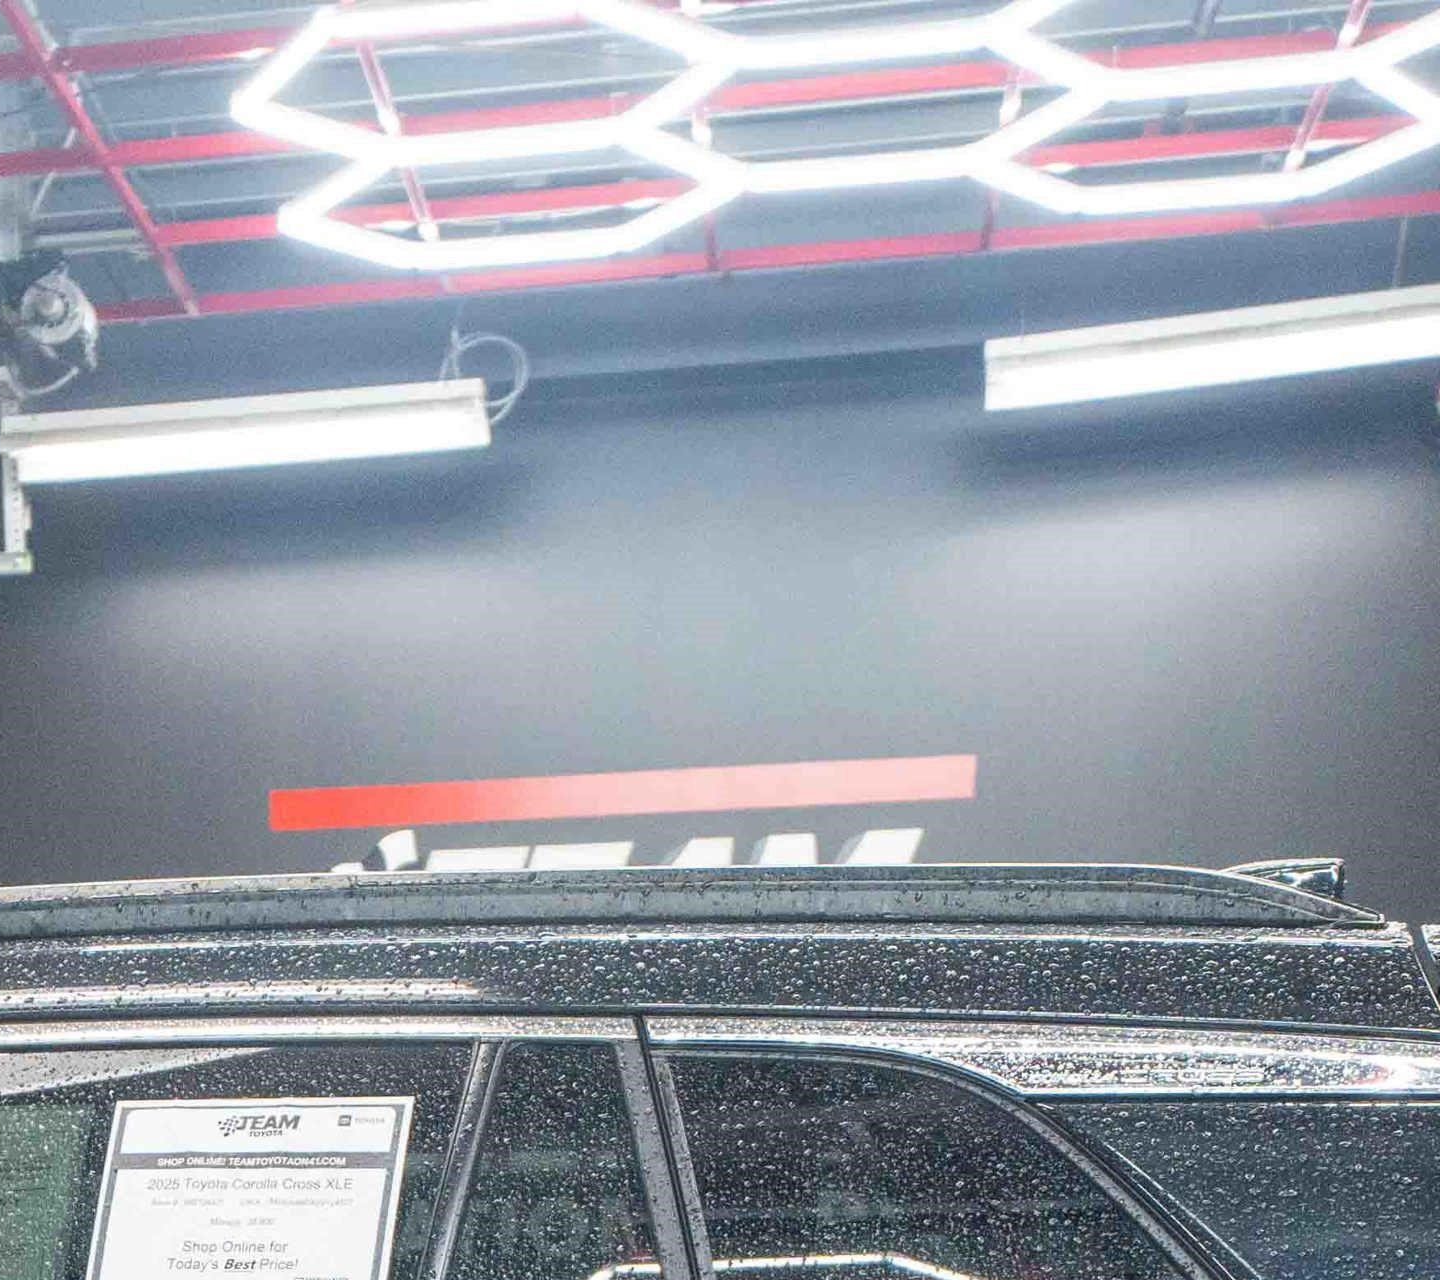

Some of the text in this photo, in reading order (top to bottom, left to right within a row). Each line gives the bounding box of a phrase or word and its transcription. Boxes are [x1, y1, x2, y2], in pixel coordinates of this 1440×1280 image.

[236, 1115, 301, 1130] TEAM
[249, 1130, 283, 1138] TOYOTA
[157, 1158, 185, 1167] SHOP
[147, 1177, 353, 1192] 2025 Toyota Corolla Cross XLE
[182, 1240, 289, 1255] Shop Online for
[167, 1258, 298, 1271] Today's Best Price!
